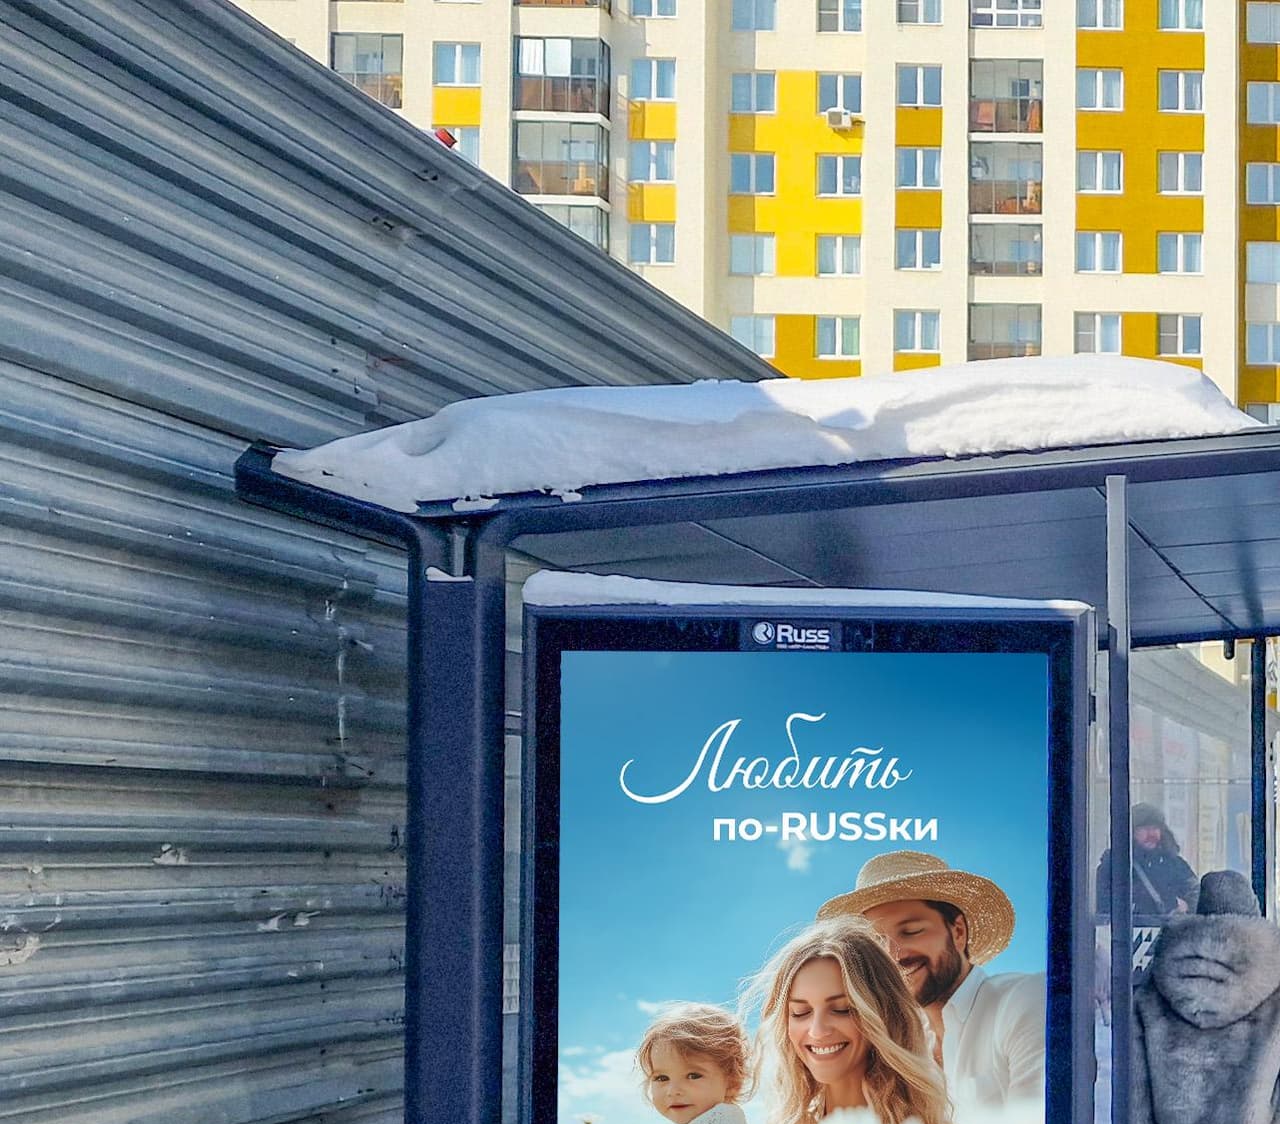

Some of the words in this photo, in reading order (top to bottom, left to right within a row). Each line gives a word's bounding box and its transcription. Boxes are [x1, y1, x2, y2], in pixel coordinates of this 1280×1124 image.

[776, 623, 831, 644] Russ
[619, 712, 913, 804] Любить
[712, 812, 938, 842] по-RUSSки
